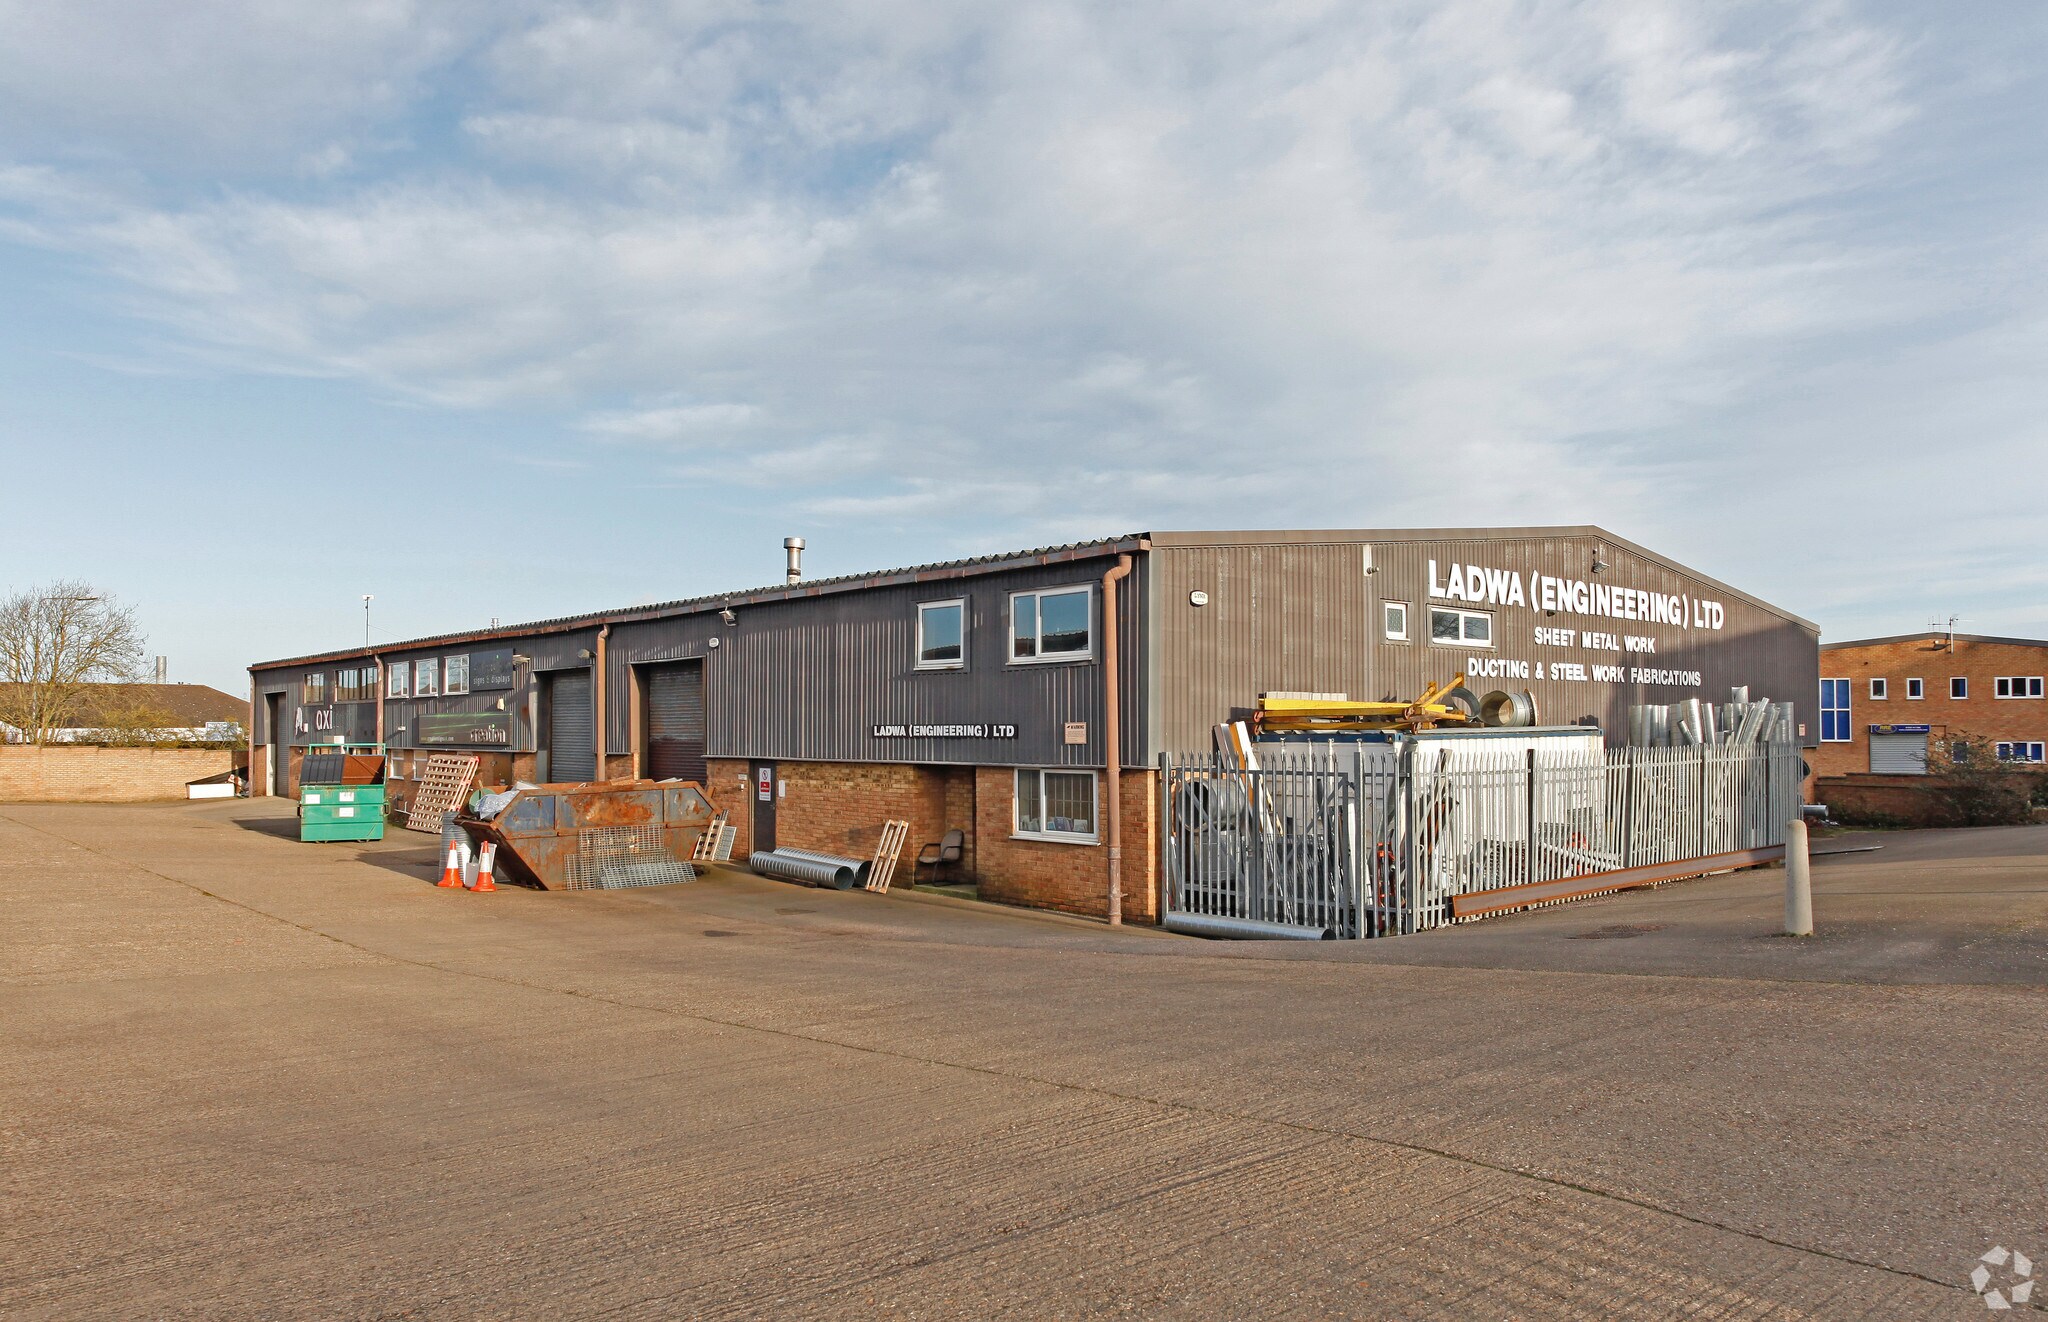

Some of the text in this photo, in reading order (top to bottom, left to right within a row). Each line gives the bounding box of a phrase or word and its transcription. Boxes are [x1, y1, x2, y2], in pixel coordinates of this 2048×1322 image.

[1428, 559, 1724, 630] LADWA (ENGINEERING) LTD
[1534, 626, 1656, 654] SHEET METAL WORK
[1468, 658, 1701, 687] DUCTING & STEEL WORK FABRICATIONS
[470, 723, 506, 743] creation
[873, 723, 1015, 738] LADWA (ENGINEERING) LTD
